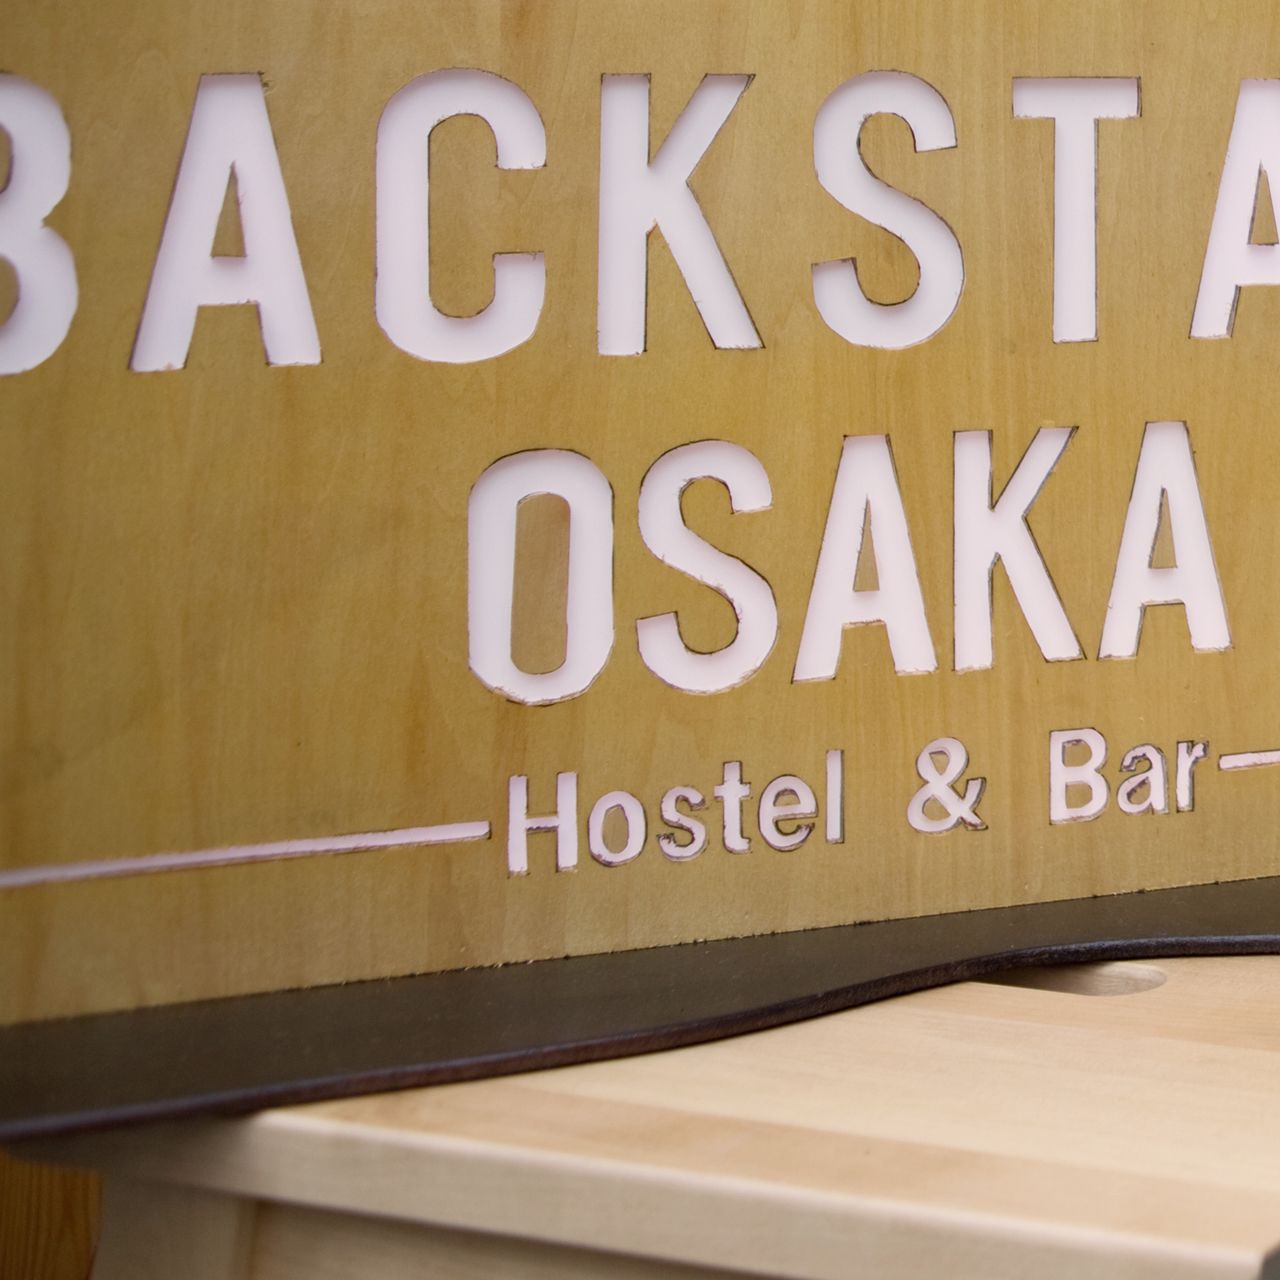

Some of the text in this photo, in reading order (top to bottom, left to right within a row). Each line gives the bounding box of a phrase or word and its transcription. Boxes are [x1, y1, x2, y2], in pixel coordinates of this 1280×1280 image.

[467, 420, 1233, 706] OSAKA
[506, 727, 1209, 877] Hostel & Bar
